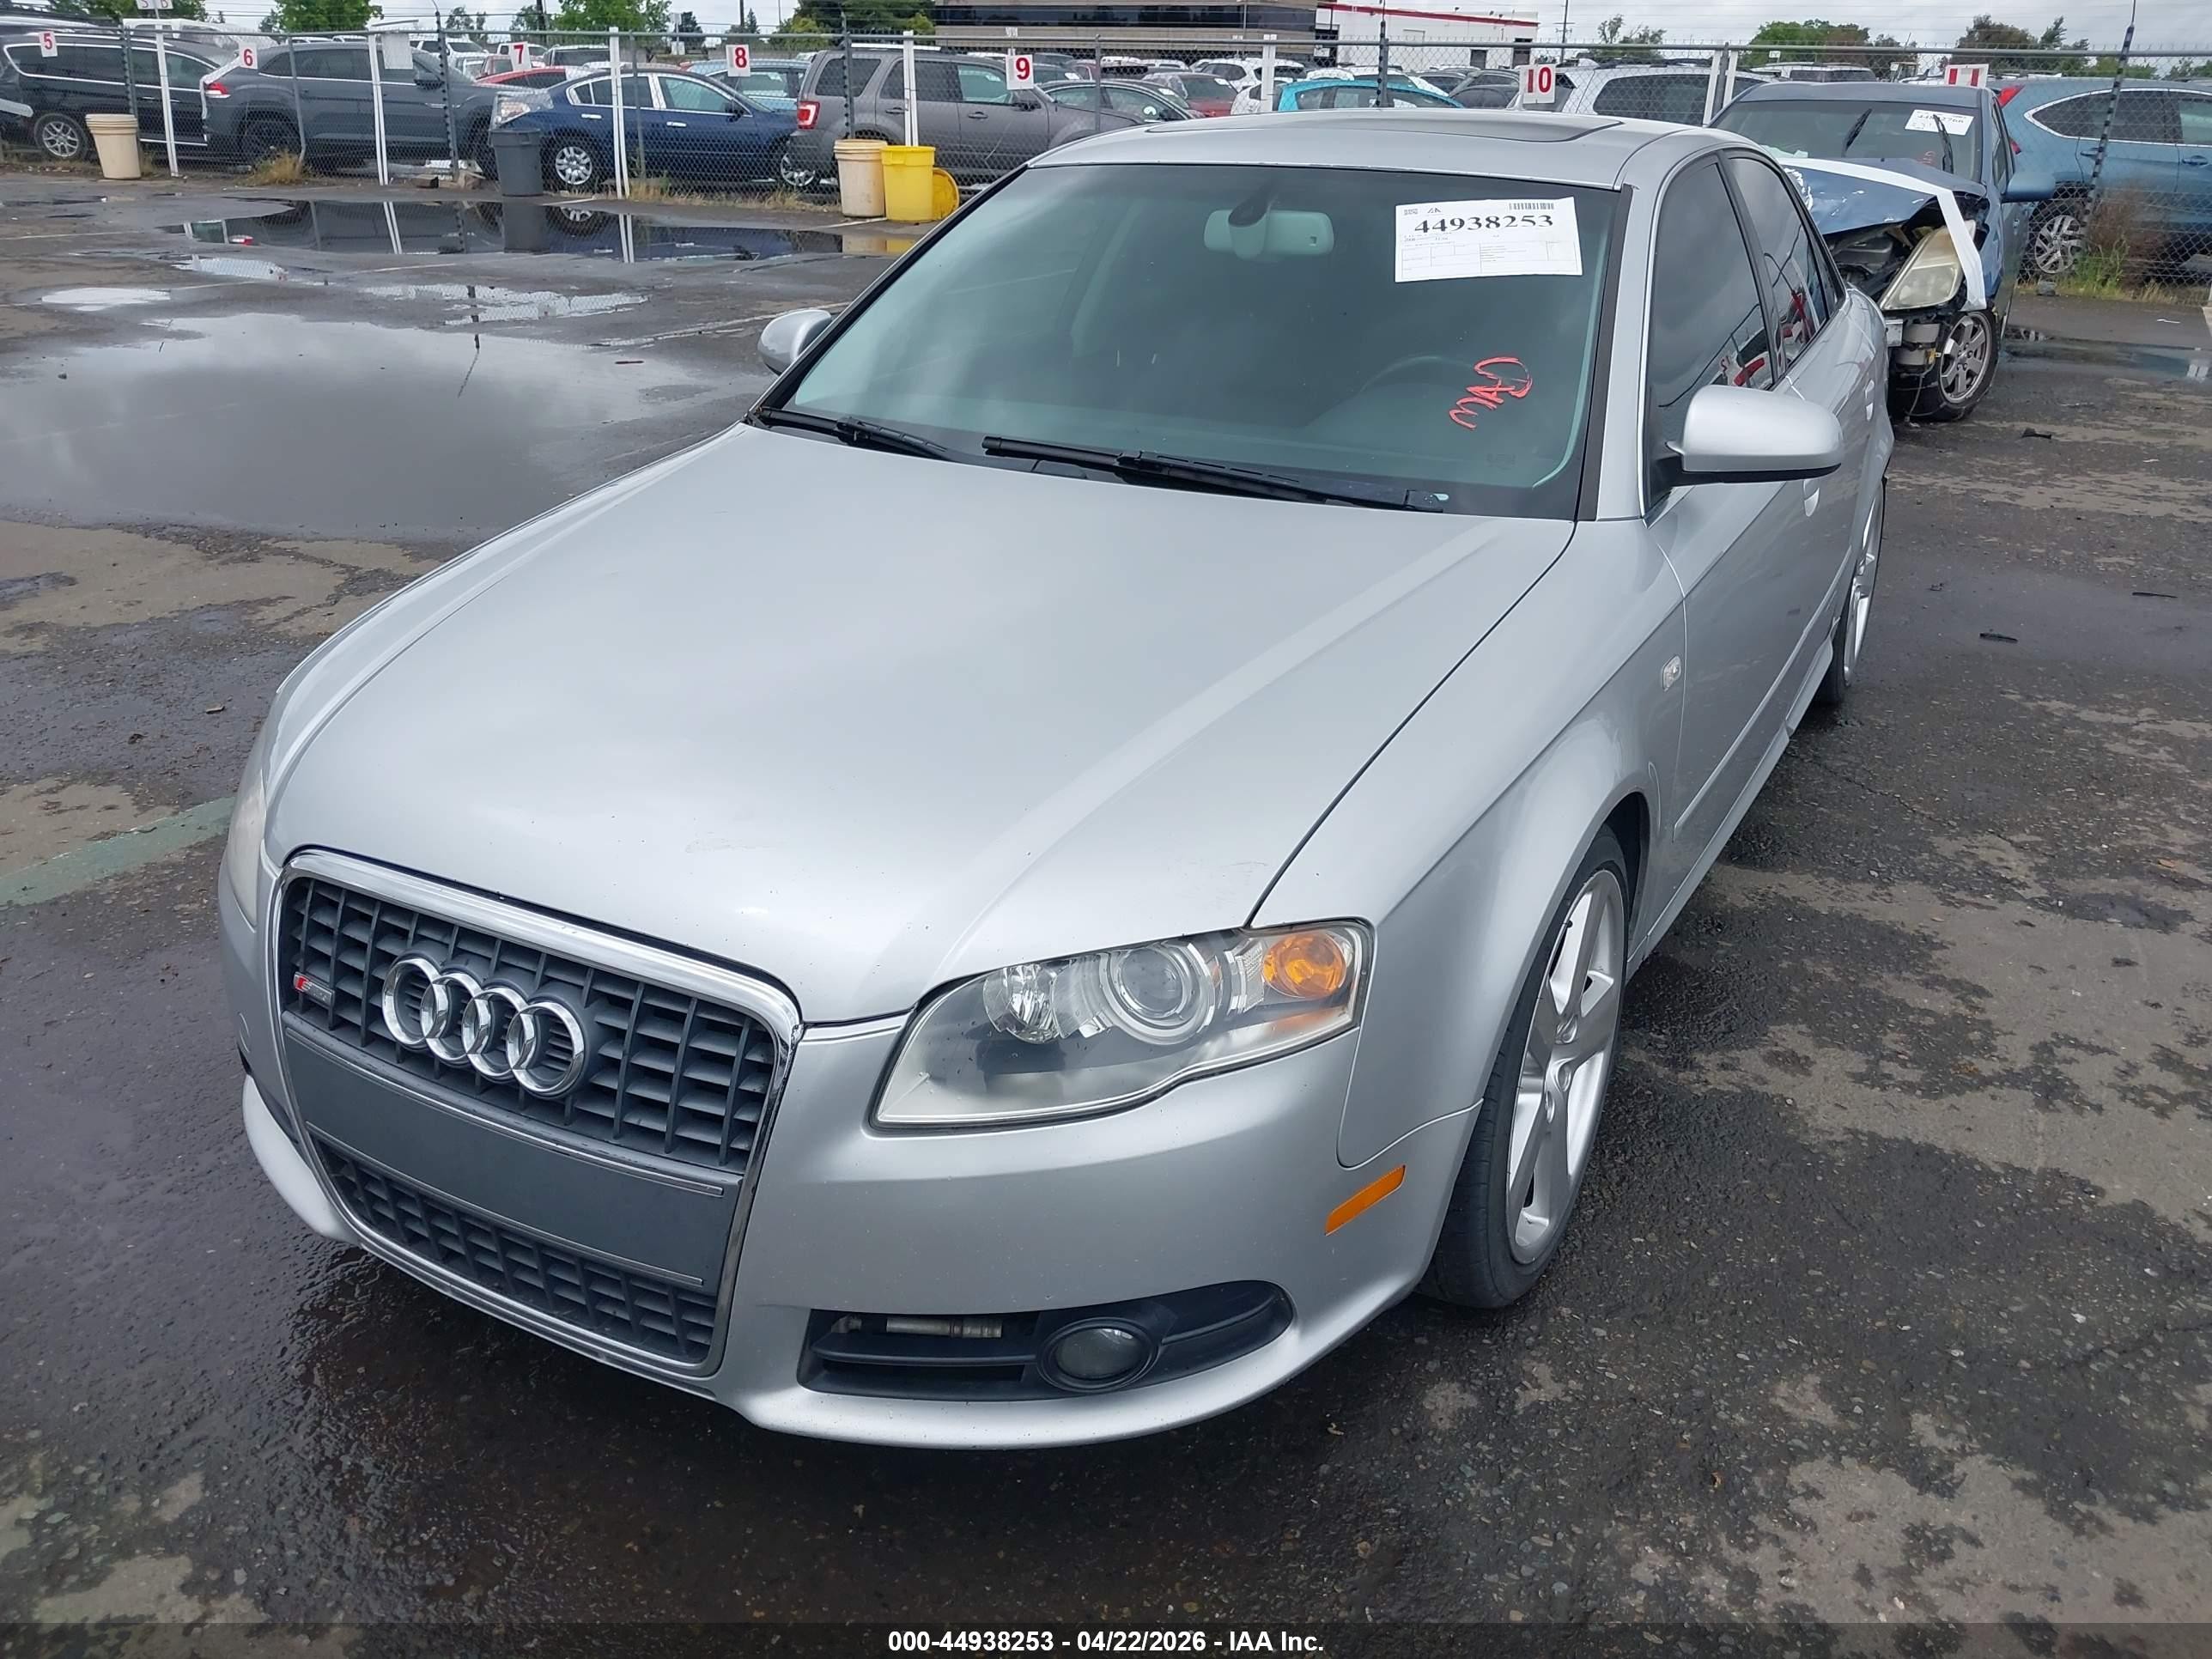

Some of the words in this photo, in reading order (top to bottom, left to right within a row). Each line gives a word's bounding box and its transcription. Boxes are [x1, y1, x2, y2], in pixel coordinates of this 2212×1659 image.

[43, 32, 52, 50] 5
[242, 49, 252, 66] 6
[514, 44, 524, 64] 7
[733, 46, 748, 69] 8
[1015, 56, 1031, 81] 9
[1948, 68, 1978, 87] 11
[1527, 66, 1553, 94] 10
[1414, 215, 1553, 234] 44938253
